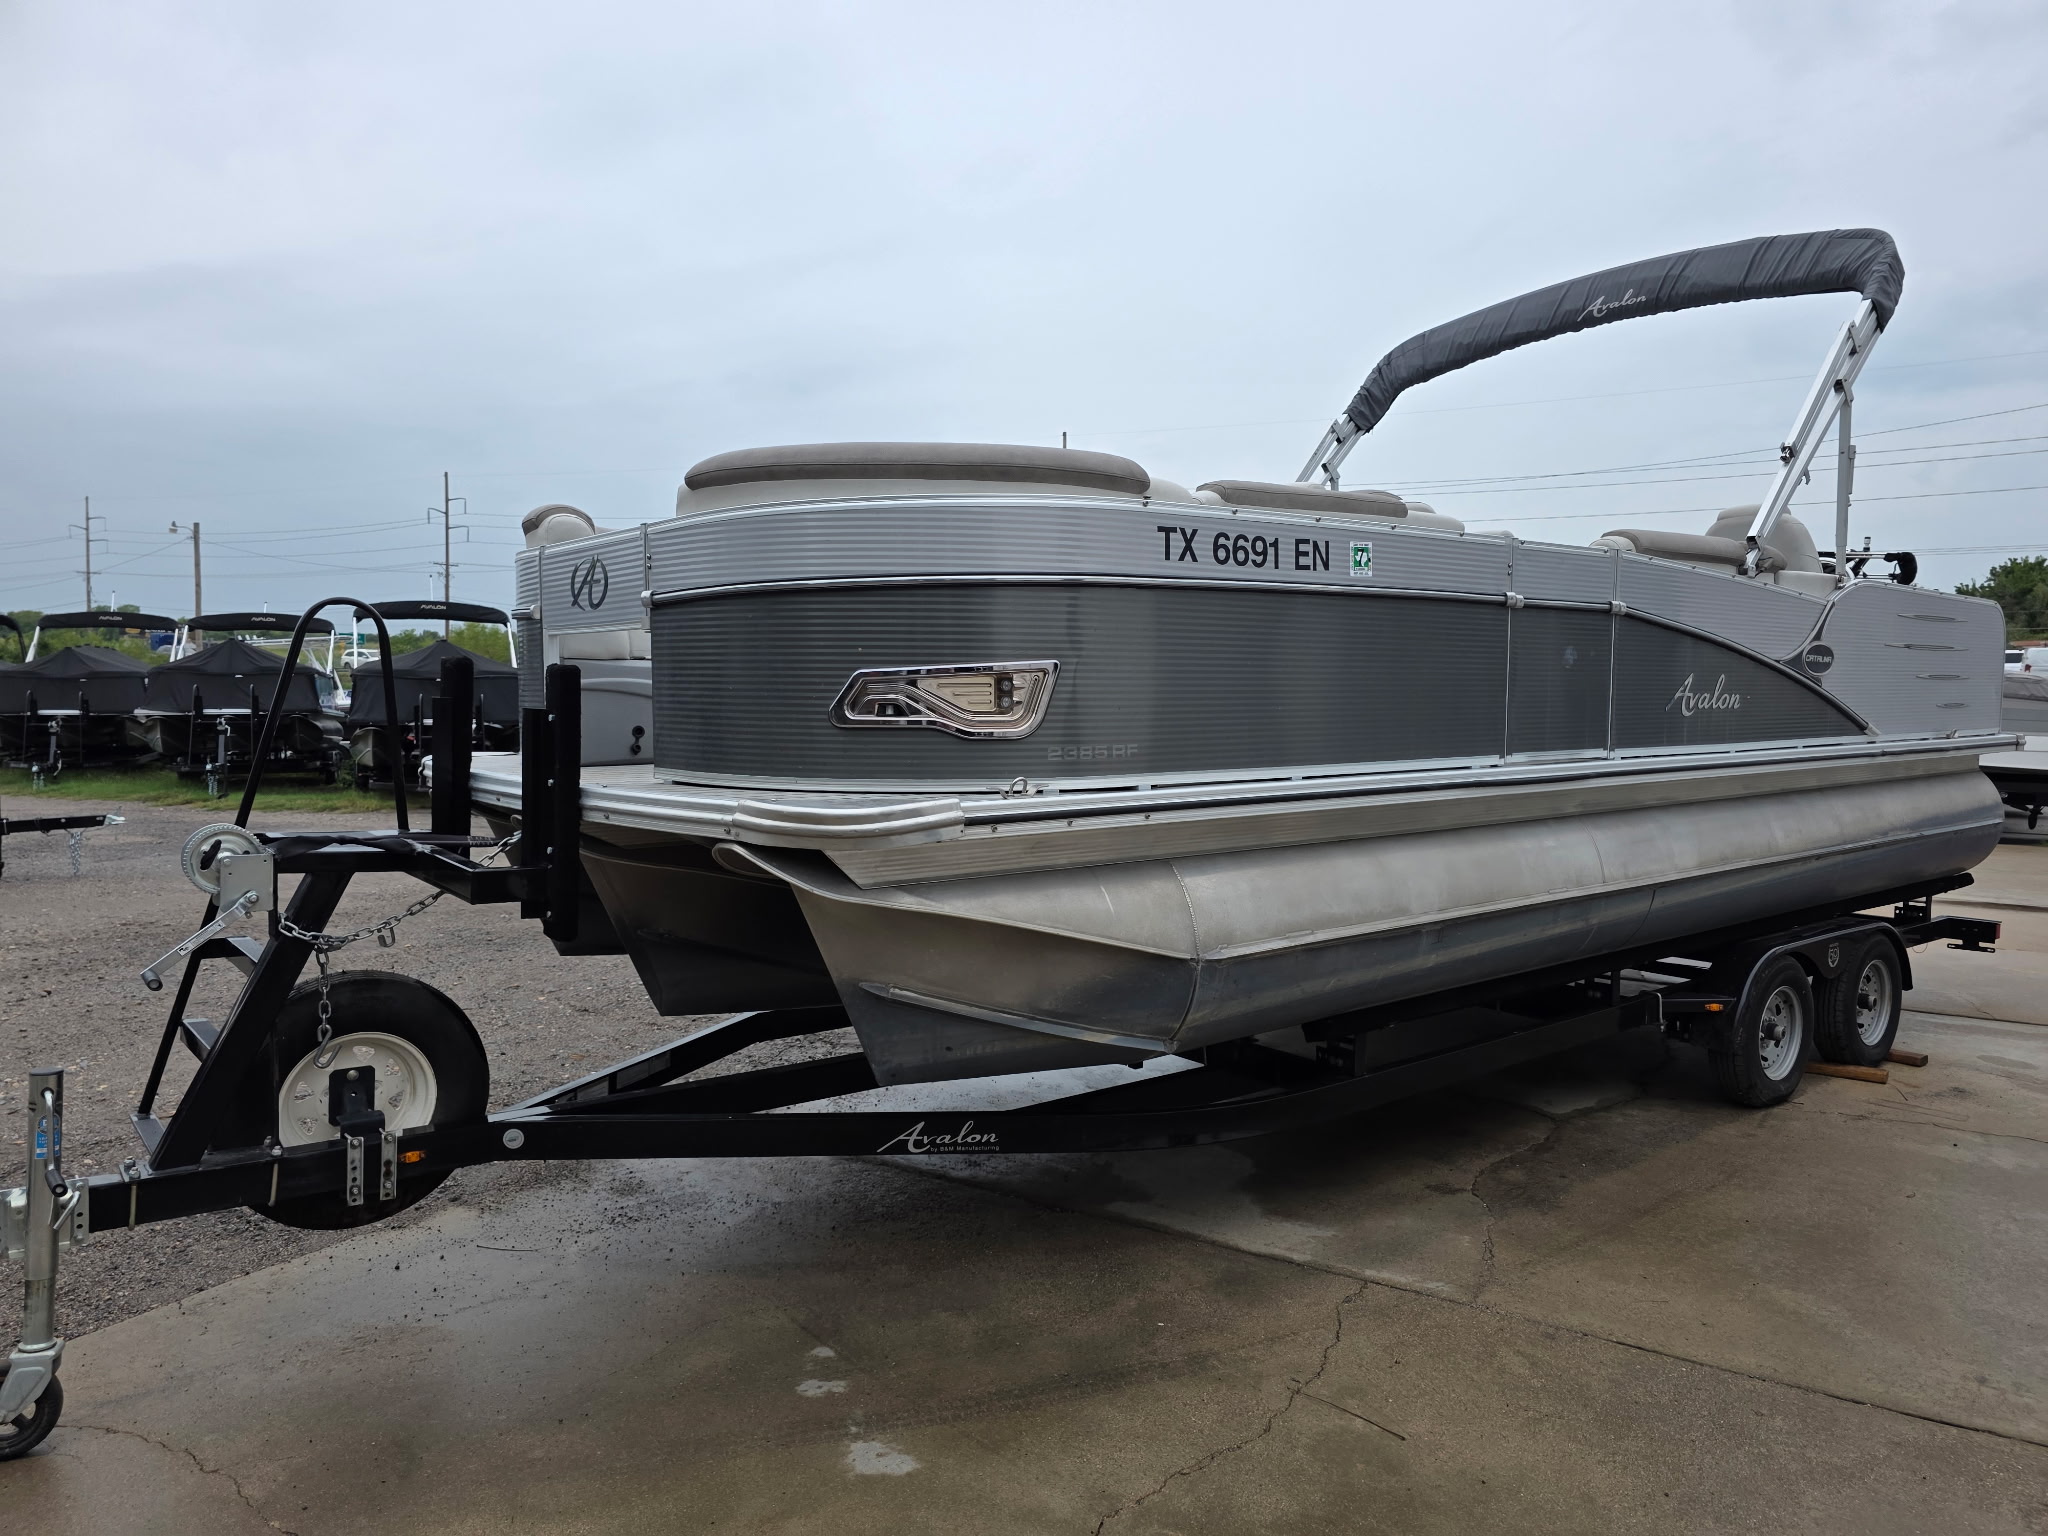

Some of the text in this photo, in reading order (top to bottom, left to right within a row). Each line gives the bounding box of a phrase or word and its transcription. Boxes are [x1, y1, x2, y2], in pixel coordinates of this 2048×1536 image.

[1577, 288, 1647, 322] Avalon
[1157, 525, 1199, 563] TX
[1212, 531, 1280, 570] 6691
[1294, 538, 1330, 572] EN
[1665, 672, 1741, 717] Avalon
[876, 1120, 999, 1153] Avalon
